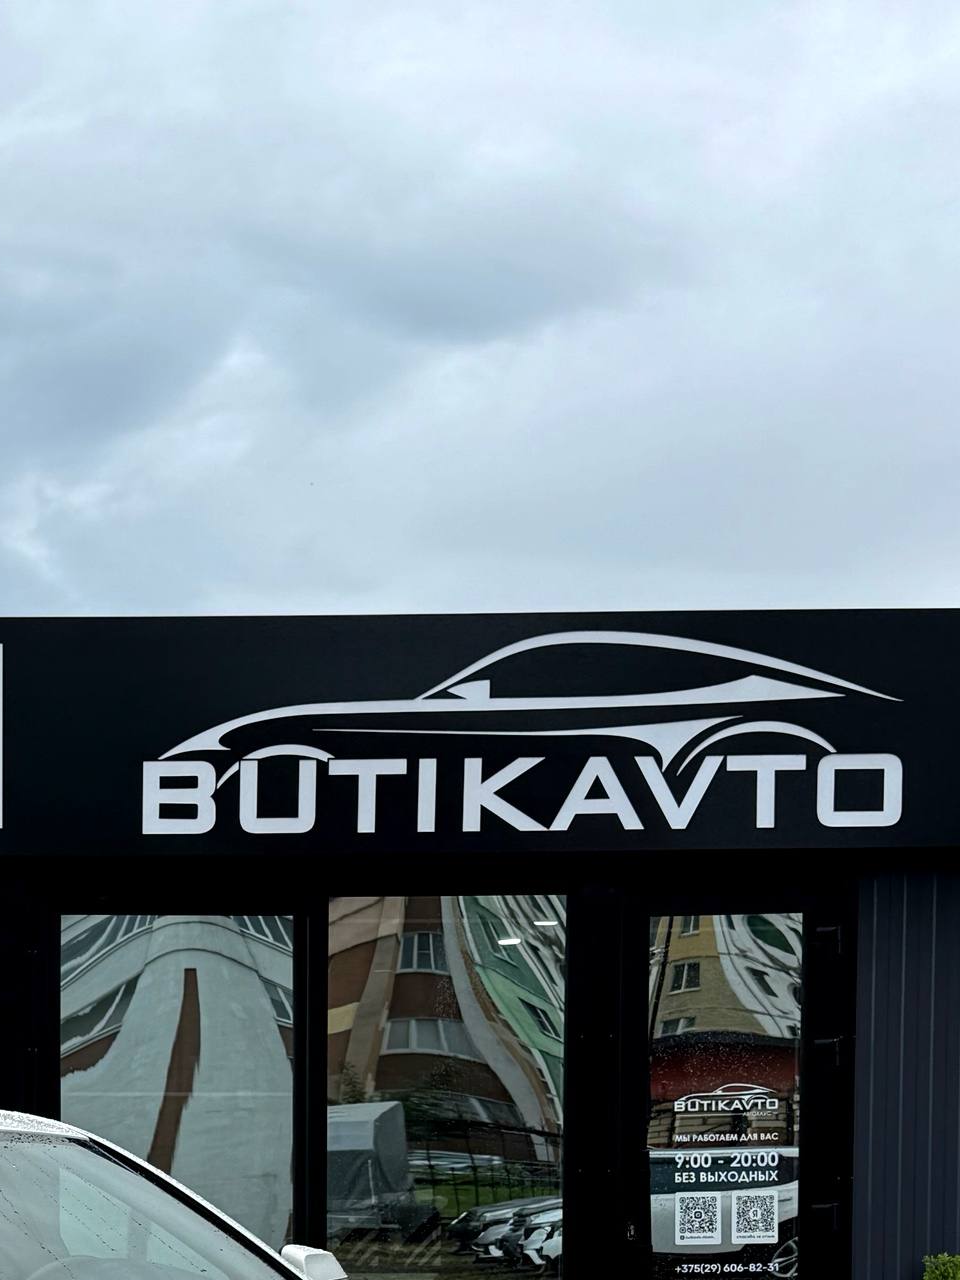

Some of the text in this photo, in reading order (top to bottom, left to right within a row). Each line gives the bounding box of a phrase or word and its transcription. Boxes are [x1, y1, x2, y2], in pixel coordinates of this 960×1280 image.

[142, 752, 903, 835] BUTIKAVTO
[674, 1099, 778, 1112] BUTIKAVTO
[692, 1134, 738, 1142] РАБОТАЕМ
[739, 1133, 758, 1142] ДЛЯ
[760, 1132, 779, 1141] ВАС
[674, 1153, 712, 1169] 9:00
[730, 1152, 779, 1167] 20:00
[674, 1170, 779, 1183] БЕЗ ВЫХОДНЫХ
[674, 1262, 779, 1274] +375(29) 606-82-31
